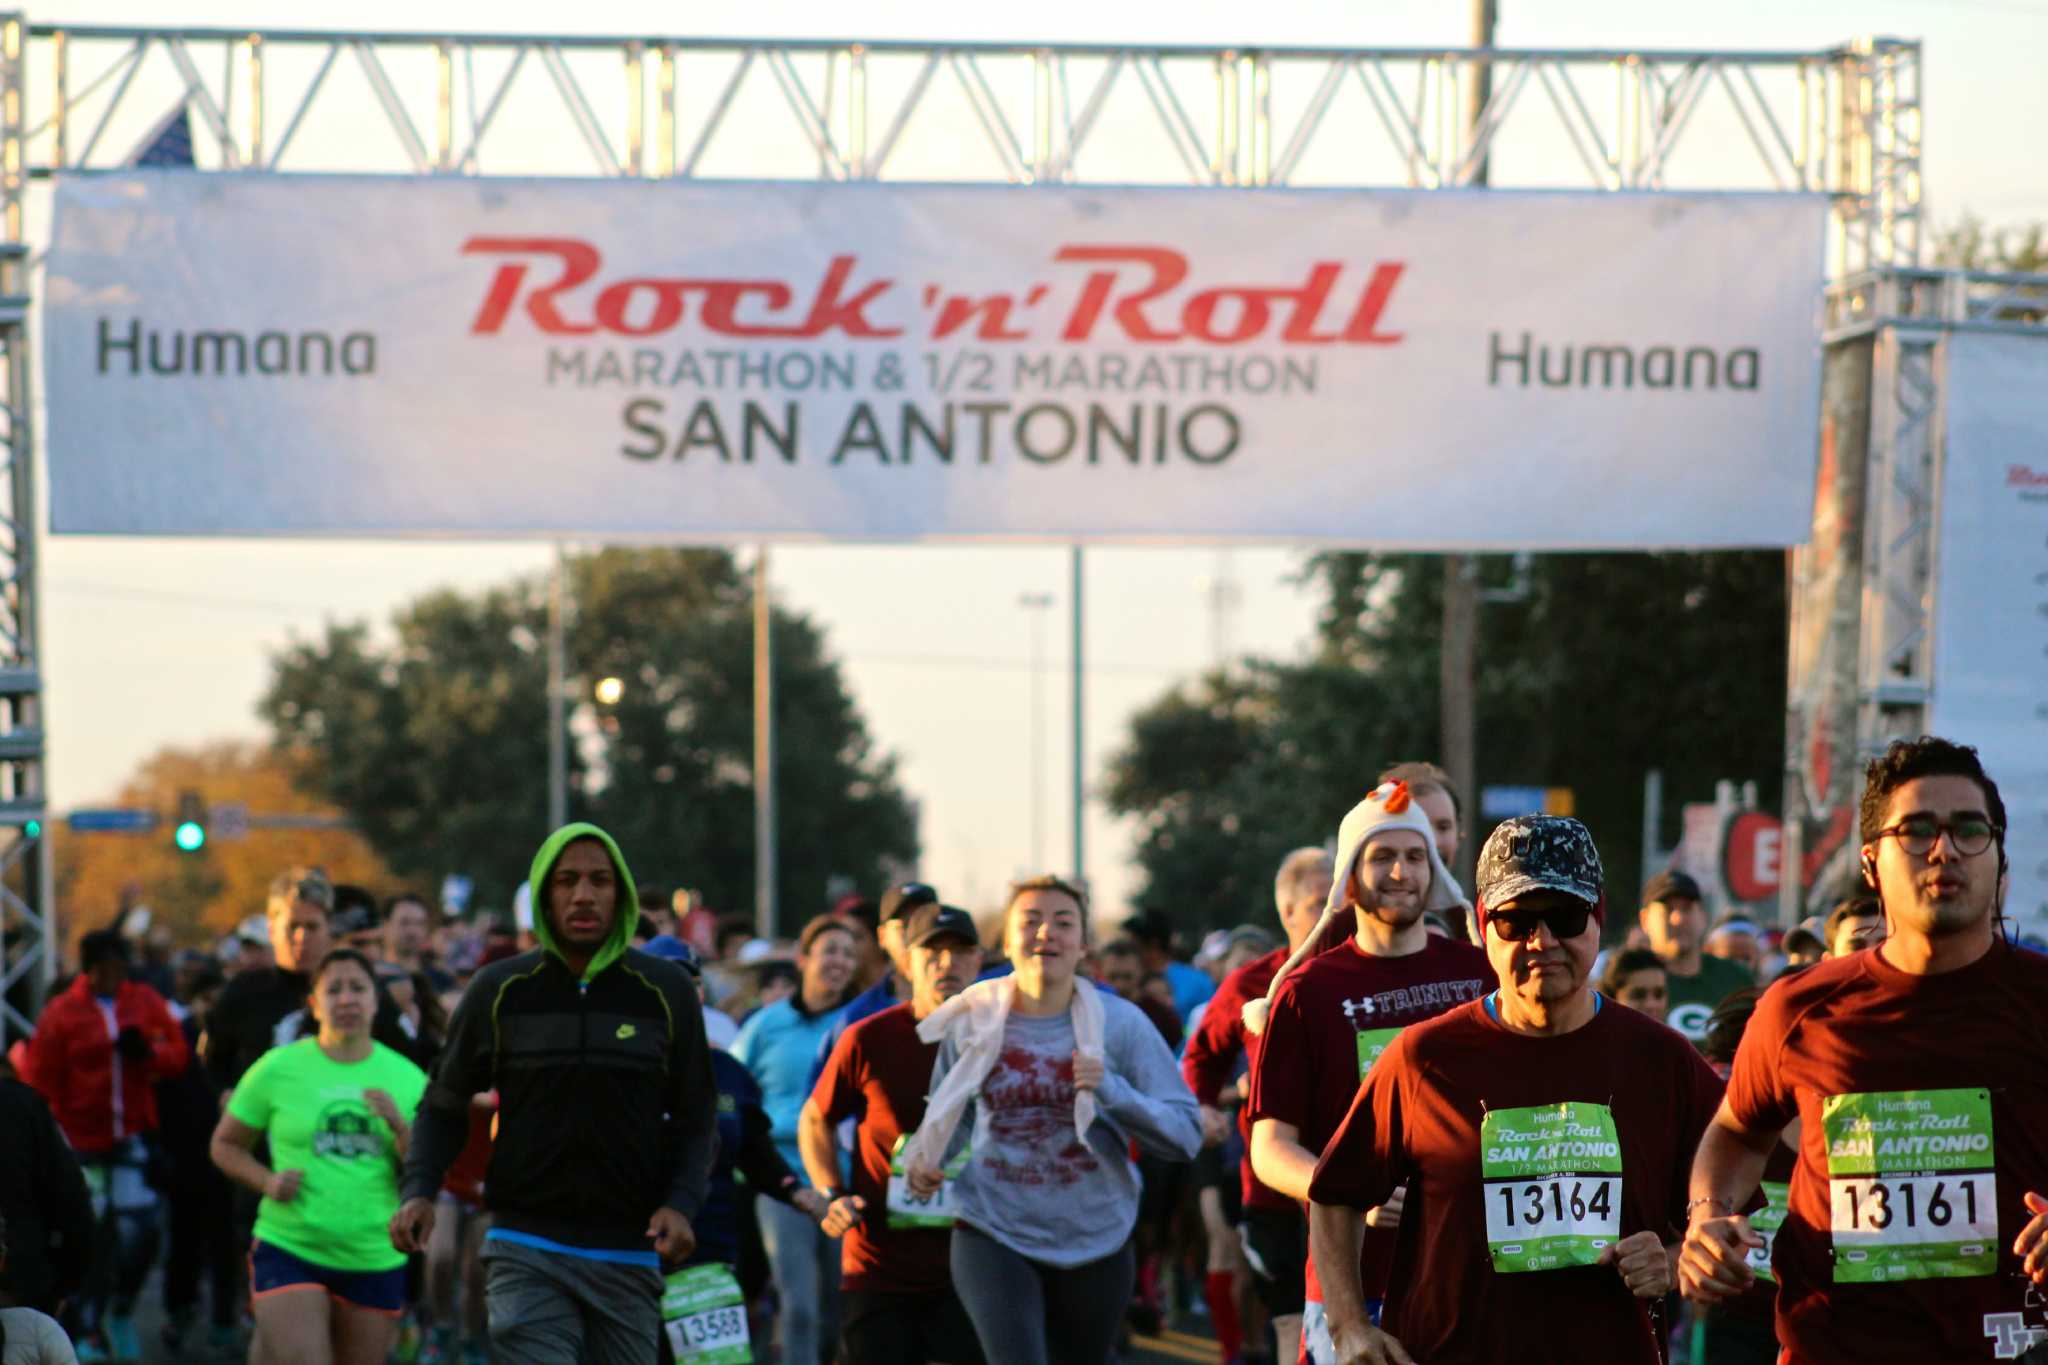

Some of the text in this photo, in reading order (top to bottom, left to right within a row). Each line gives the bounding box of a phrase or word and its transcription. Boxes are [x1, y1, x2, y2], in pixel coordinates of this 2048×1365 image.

[458, 236, 905, 340] Rock
[1050, 245, 1409, 346] Roll
[97, 318, 376, 377] Humana
[545, 347, 1318, 395] MARATHON & 1/2 MARATHON
[1488, 332, 1762, 390] Humana
[621, 400, 1241, 466] SAN ANTONIO
[1373, 979, 1483, 1013] TRINITY
[1496, 1128, 1550, 1144] Rock
[1565, 1122, 1602, 1138] Roll
[1830, 1133, 1990, 1158] SAN ANTONIO
[1919, 1114, 1970, 1131] Roll
[1487, 1141, 1618, 1163] SAN ANTONIO
[1499, 1181, 1611, 1227] 13164
[1845, 1180, 1977, 1230] 13161
